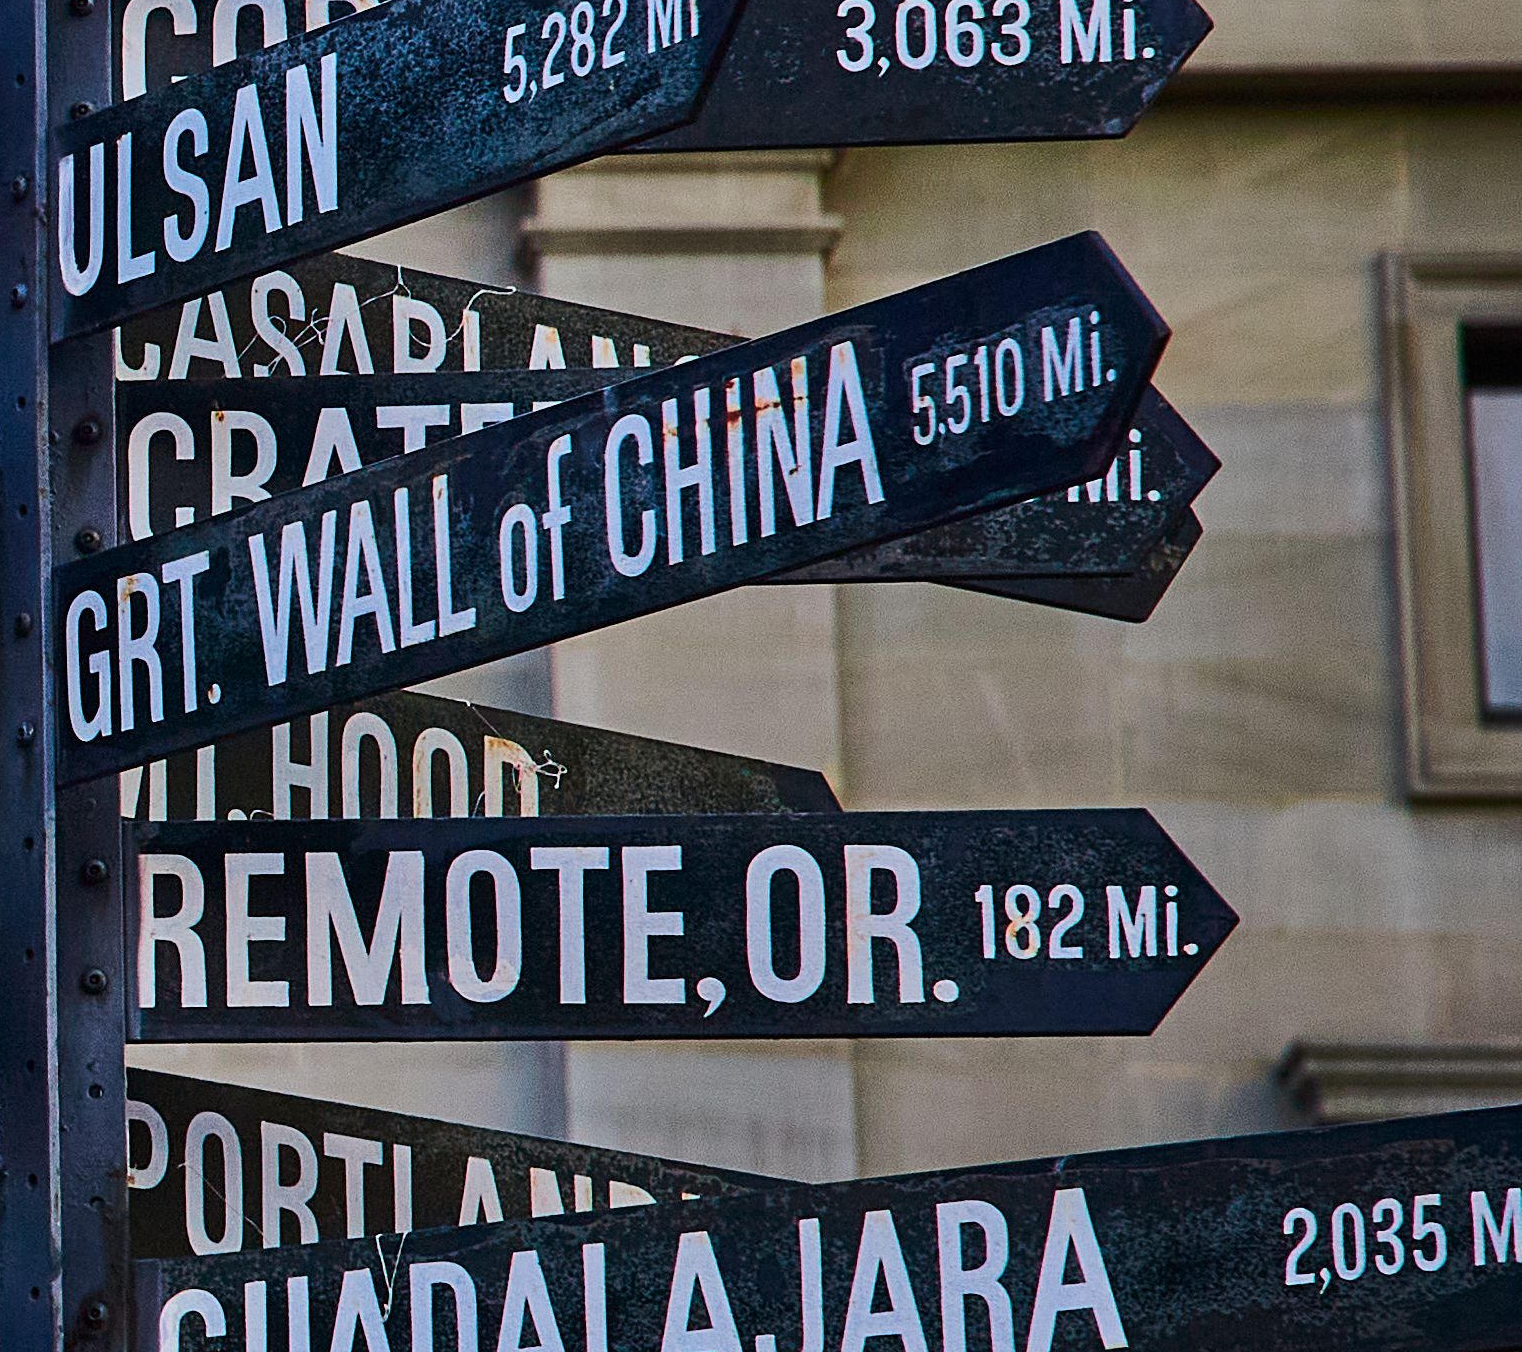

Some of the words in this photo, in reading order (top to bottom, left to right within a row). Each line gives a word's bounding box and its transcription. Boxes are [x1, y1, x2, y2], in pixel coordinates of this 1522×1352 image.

[58, 53, 340, 299] ULSAN
[64, 549, 222, 744] GRT.
[249, 474, 477, 687] WALL
[499, 434, 574, 614] of
[602, 340, 886, 578] CHINA
[1041, 310, 1117, 403] Mi.
[975, 883, 1085, 961] 182
[1107, 883, 1200, 961] Mi.
[1283, 1193, 1448, 1295] 2,035
